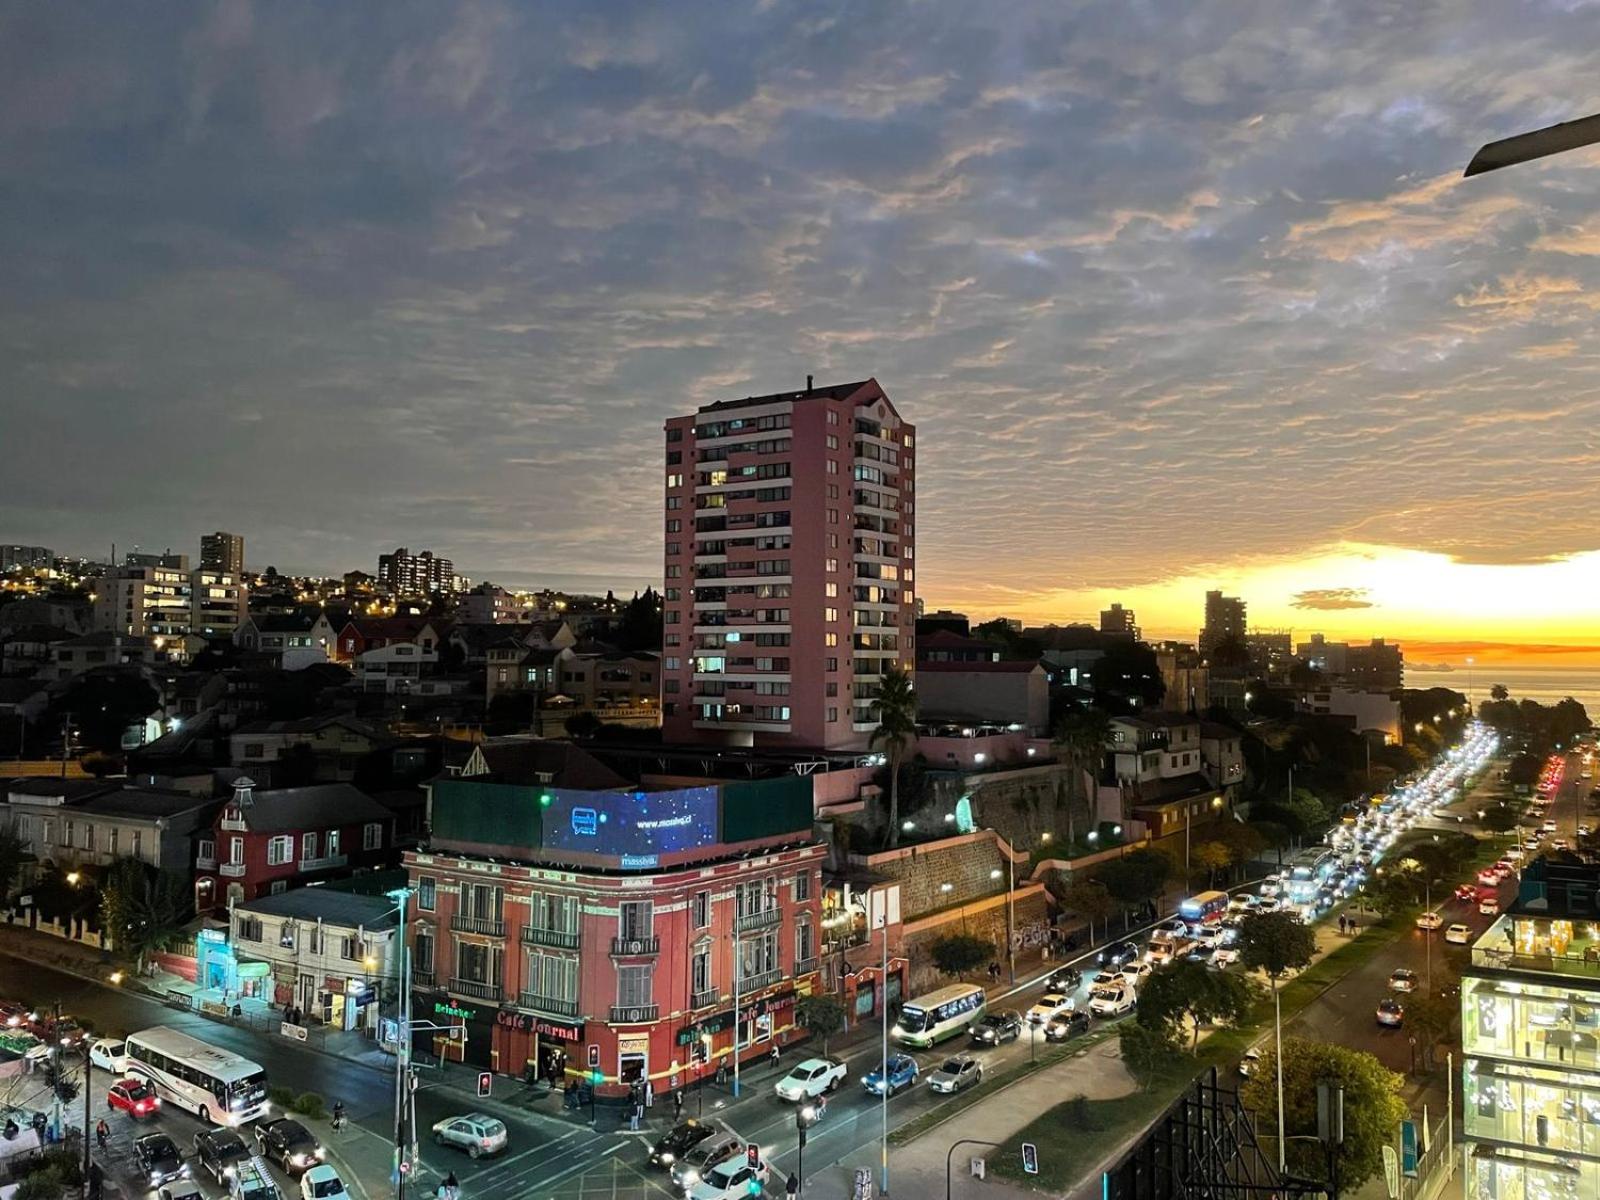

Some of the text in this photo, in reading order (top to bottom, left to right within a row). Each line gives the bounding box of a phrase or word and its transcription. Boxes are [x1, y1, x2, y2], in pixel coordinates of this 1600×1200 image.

[765, 995, 799, 1014] Journa
[497, 1011, 578, 1041] Café Journal
